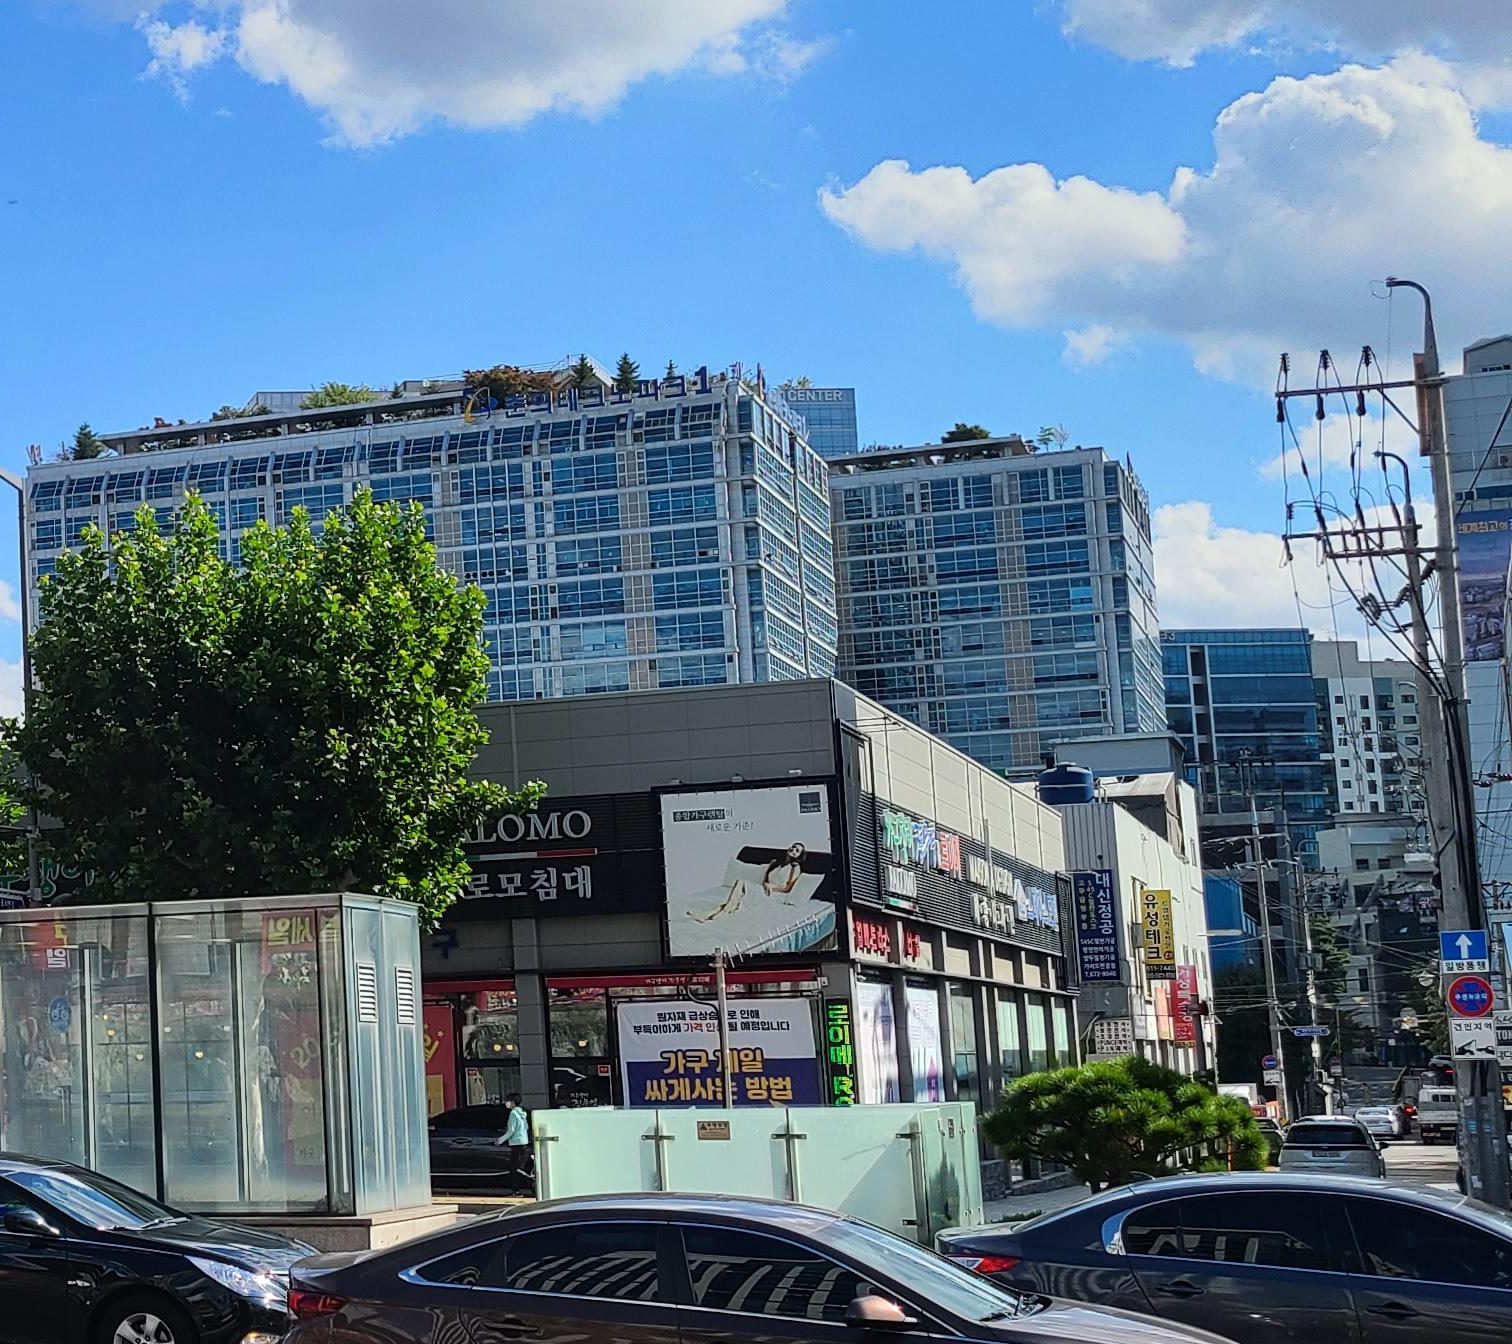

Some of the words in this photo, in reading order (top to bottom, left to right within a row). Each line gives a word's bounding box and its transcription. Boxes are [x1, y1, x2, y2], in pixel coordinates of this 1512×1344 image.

[788, 390, 842, 401] CENTER
[1095, 872, 1114, 934] 대신정공
[1143, 894, 1162, 960] 유성테크
[1445, 961, 1486, 972] 일방통행
[656, 1011, 687, 1022] 원자재
[688, 1009, 737, 1022] 급상승로
[740, 1009, 761, 1020] 인해
[683, 1023, 704, 1033] 가격
[740, 1020, 790, 1032] 예정입니다
[1453, 1022, 1493, 1032] 견인지역
[661, 1049, 709, 1075] 가구
[744, 1075, 793, 1101] 방법
